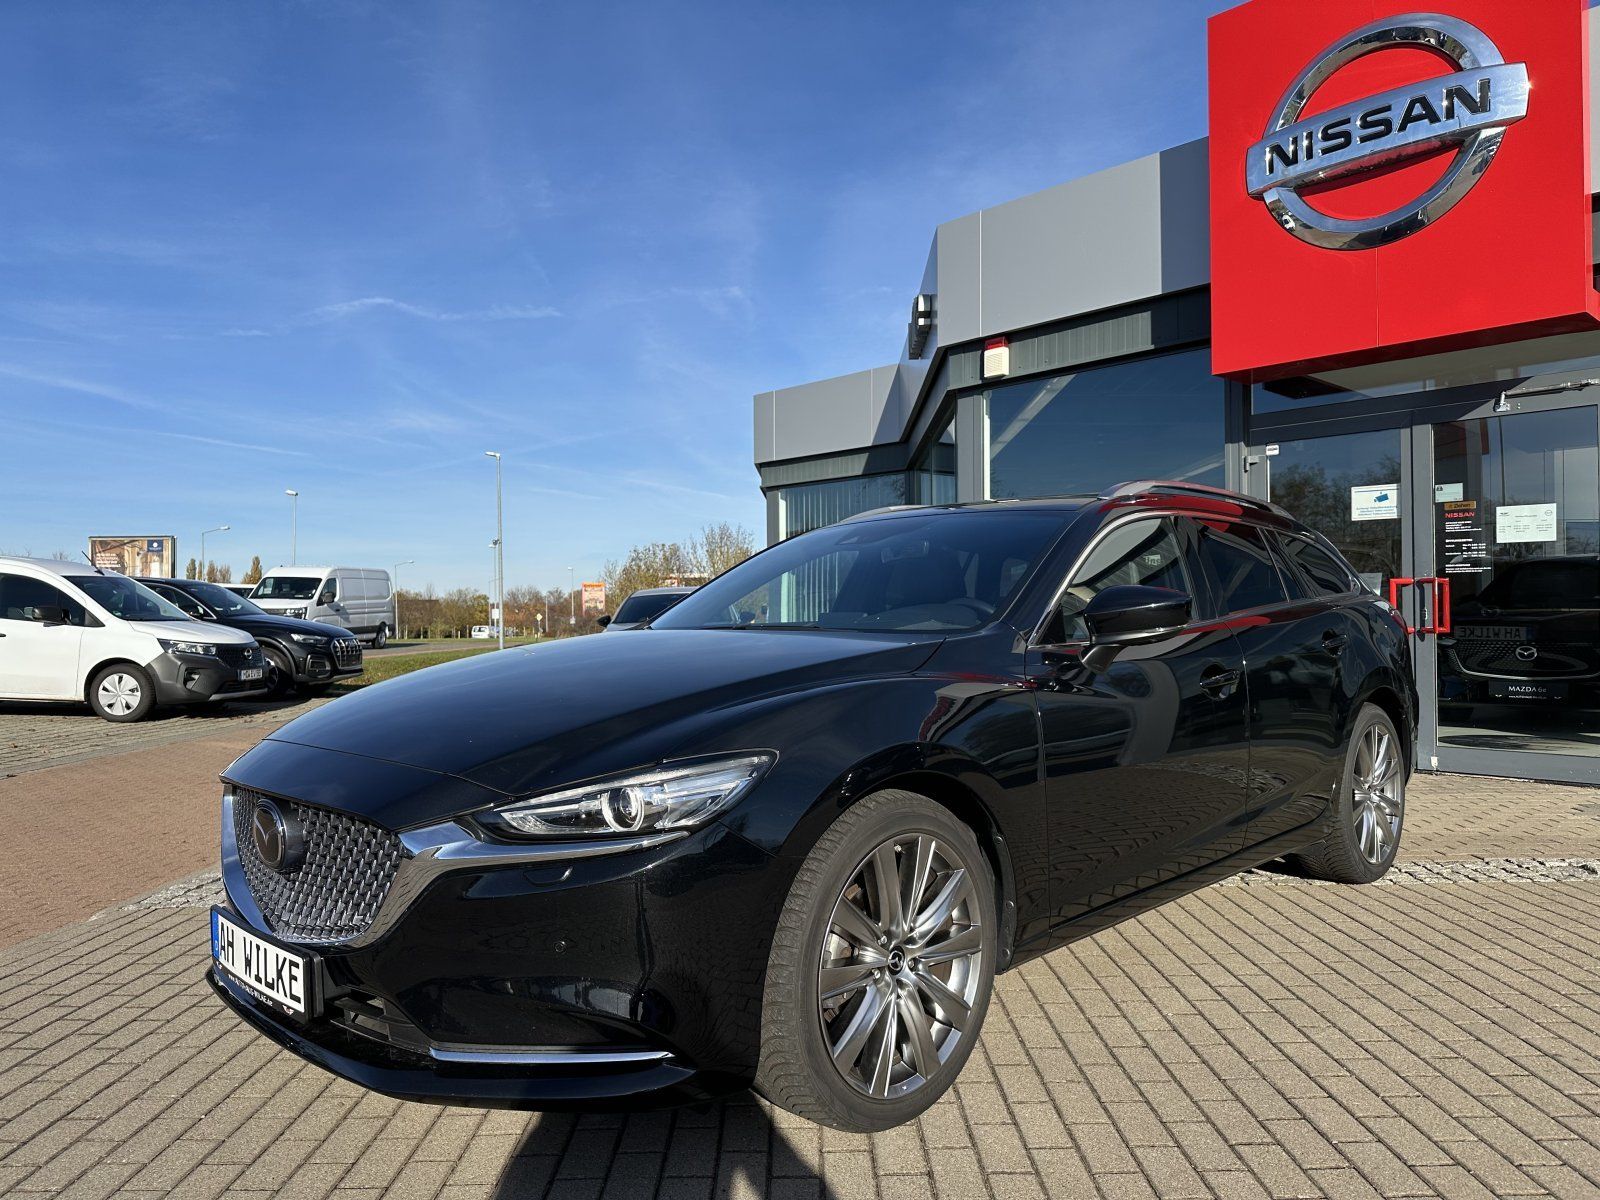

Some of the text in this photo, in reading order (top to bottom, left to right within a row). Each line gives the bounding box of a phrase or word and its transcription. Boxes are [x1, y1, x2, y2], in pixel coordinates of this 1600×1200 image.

[1265, 78, 1491, 175] NISSAN
[220, 921, 235, 967] AH
[243, 936, 302, 1005] WILKE
